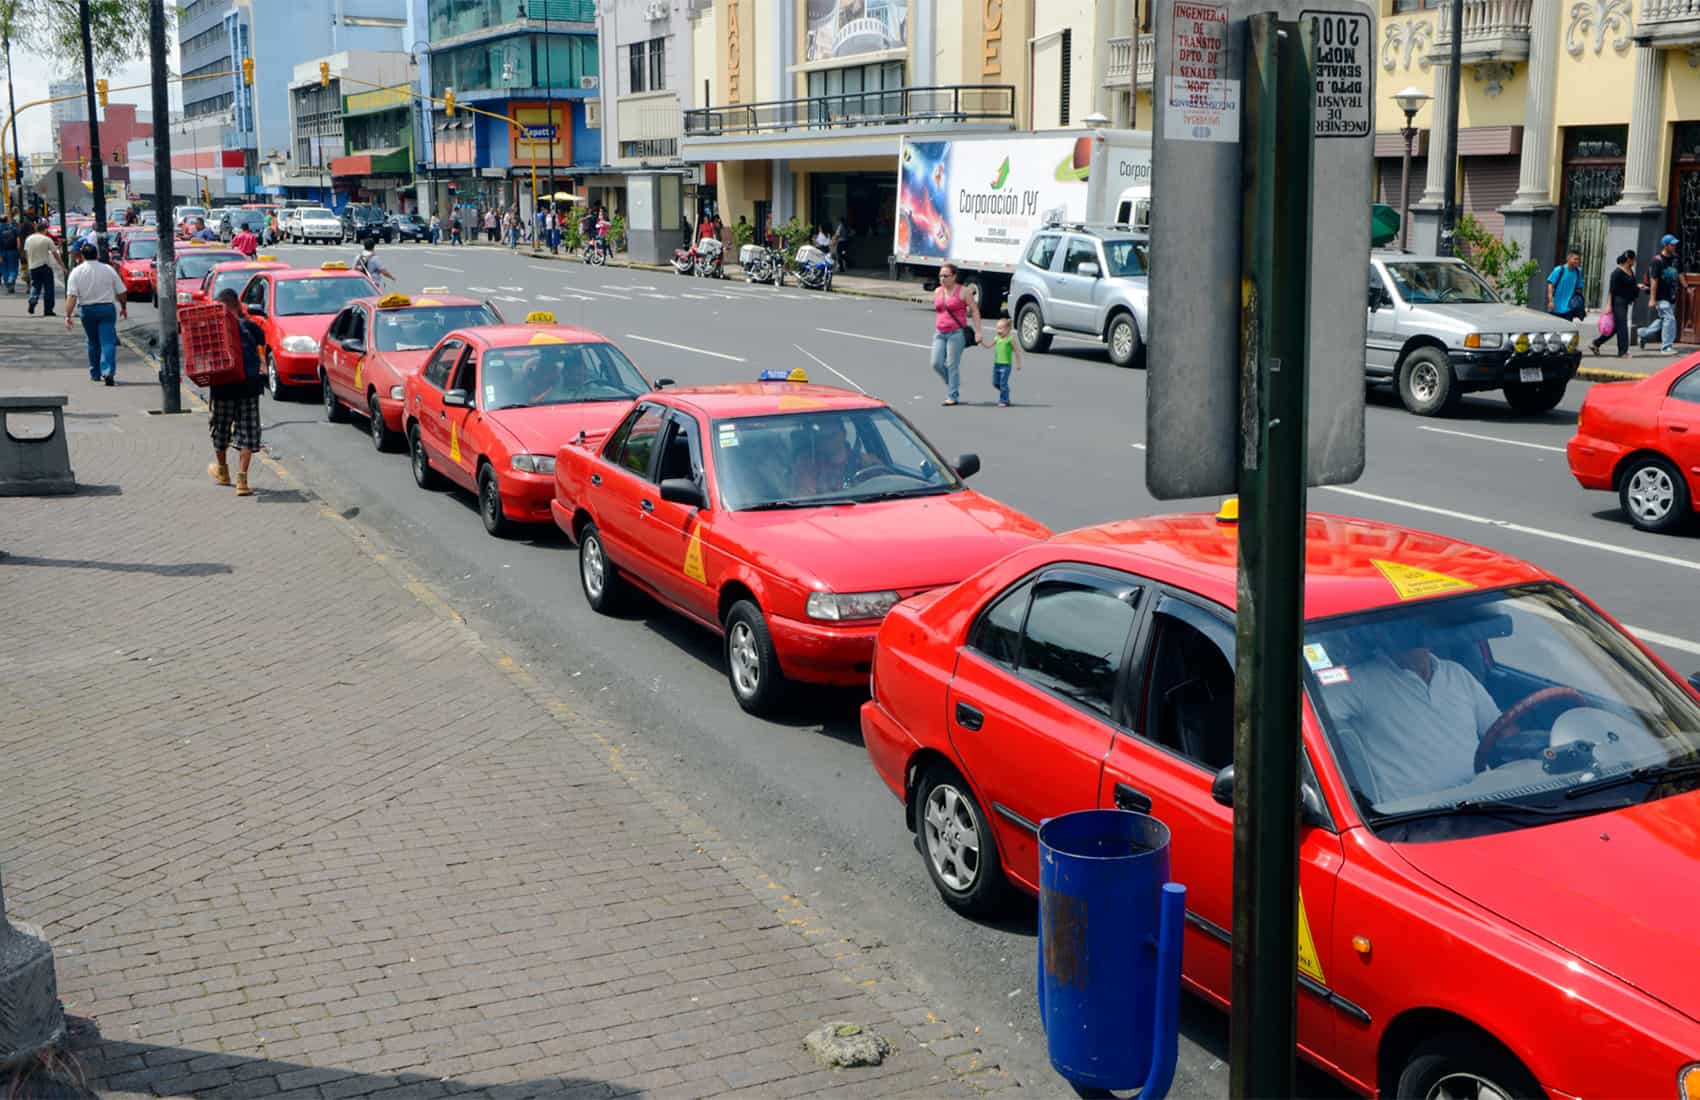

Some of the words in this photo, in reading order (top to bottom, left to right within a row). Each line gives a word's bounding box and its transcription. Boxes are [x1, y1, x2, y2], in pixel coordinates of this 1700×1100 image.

[1193, 22, 1204, 35] DE
[1178, 33, 1221, 50] TRANSITO
[1207, 51, 1219, 65] DE
[1317, 47, 1355, 65] MOPT
[1316, 64, 1361, 80] SEÑALE
[1316, 81, 1324, 93] D
[1317, 95, 1362, 109] TRANSIT
[1328, 109, 1342, 120] DE
[1316, 120, 1367, 133] INGENIER
[1120, 161, 1151, 181] Corpor
[960, 187, 1019, 220] Corporación
